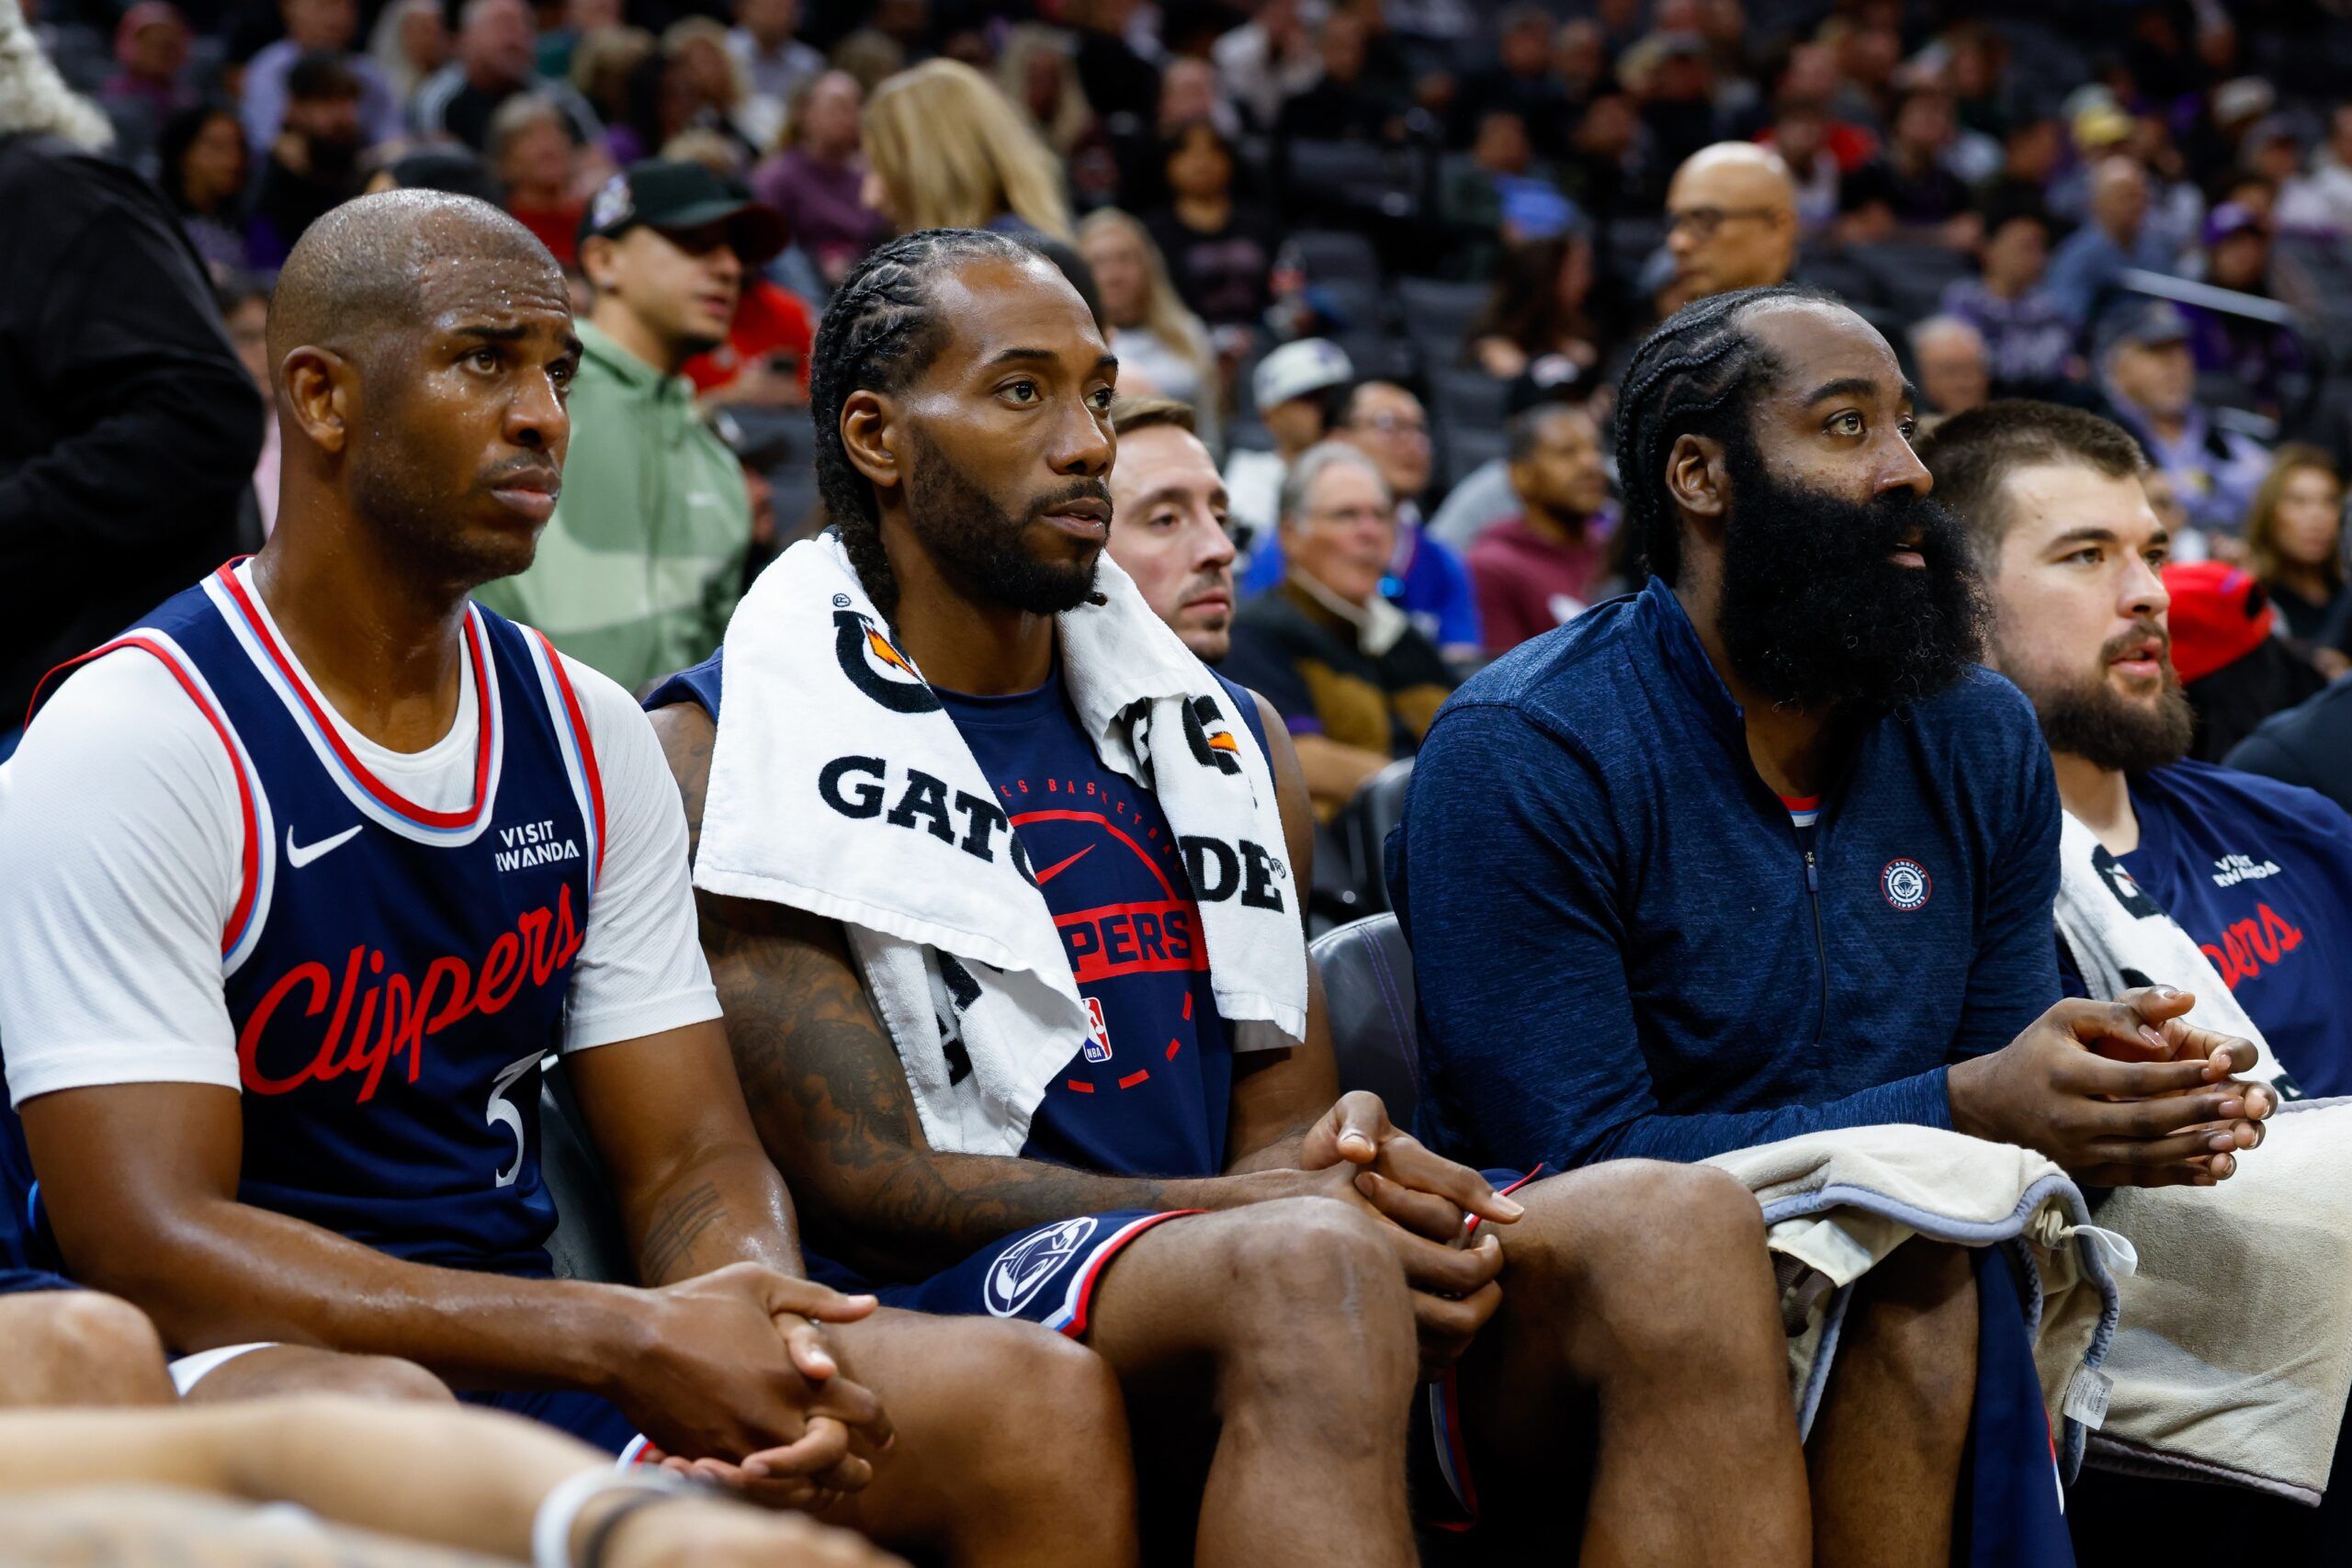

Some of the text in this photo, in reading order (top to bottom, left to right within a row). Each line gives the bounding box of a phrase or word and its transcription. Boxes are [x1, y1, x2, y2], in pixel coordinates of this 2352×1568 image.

[499, 819, 553, 848] VISIT
[1001, 778, 1188, 889] ES BASKETBA
[1883, 861, 1926, 879] LOS ANGELES
[1889, 896, 1926, 908] CLIPPERS
[1057, 909, 1192, 974] PERS
[238, 882, 584, 1105] Clippers
[1086, 1046, 1102, 1059] NBA
